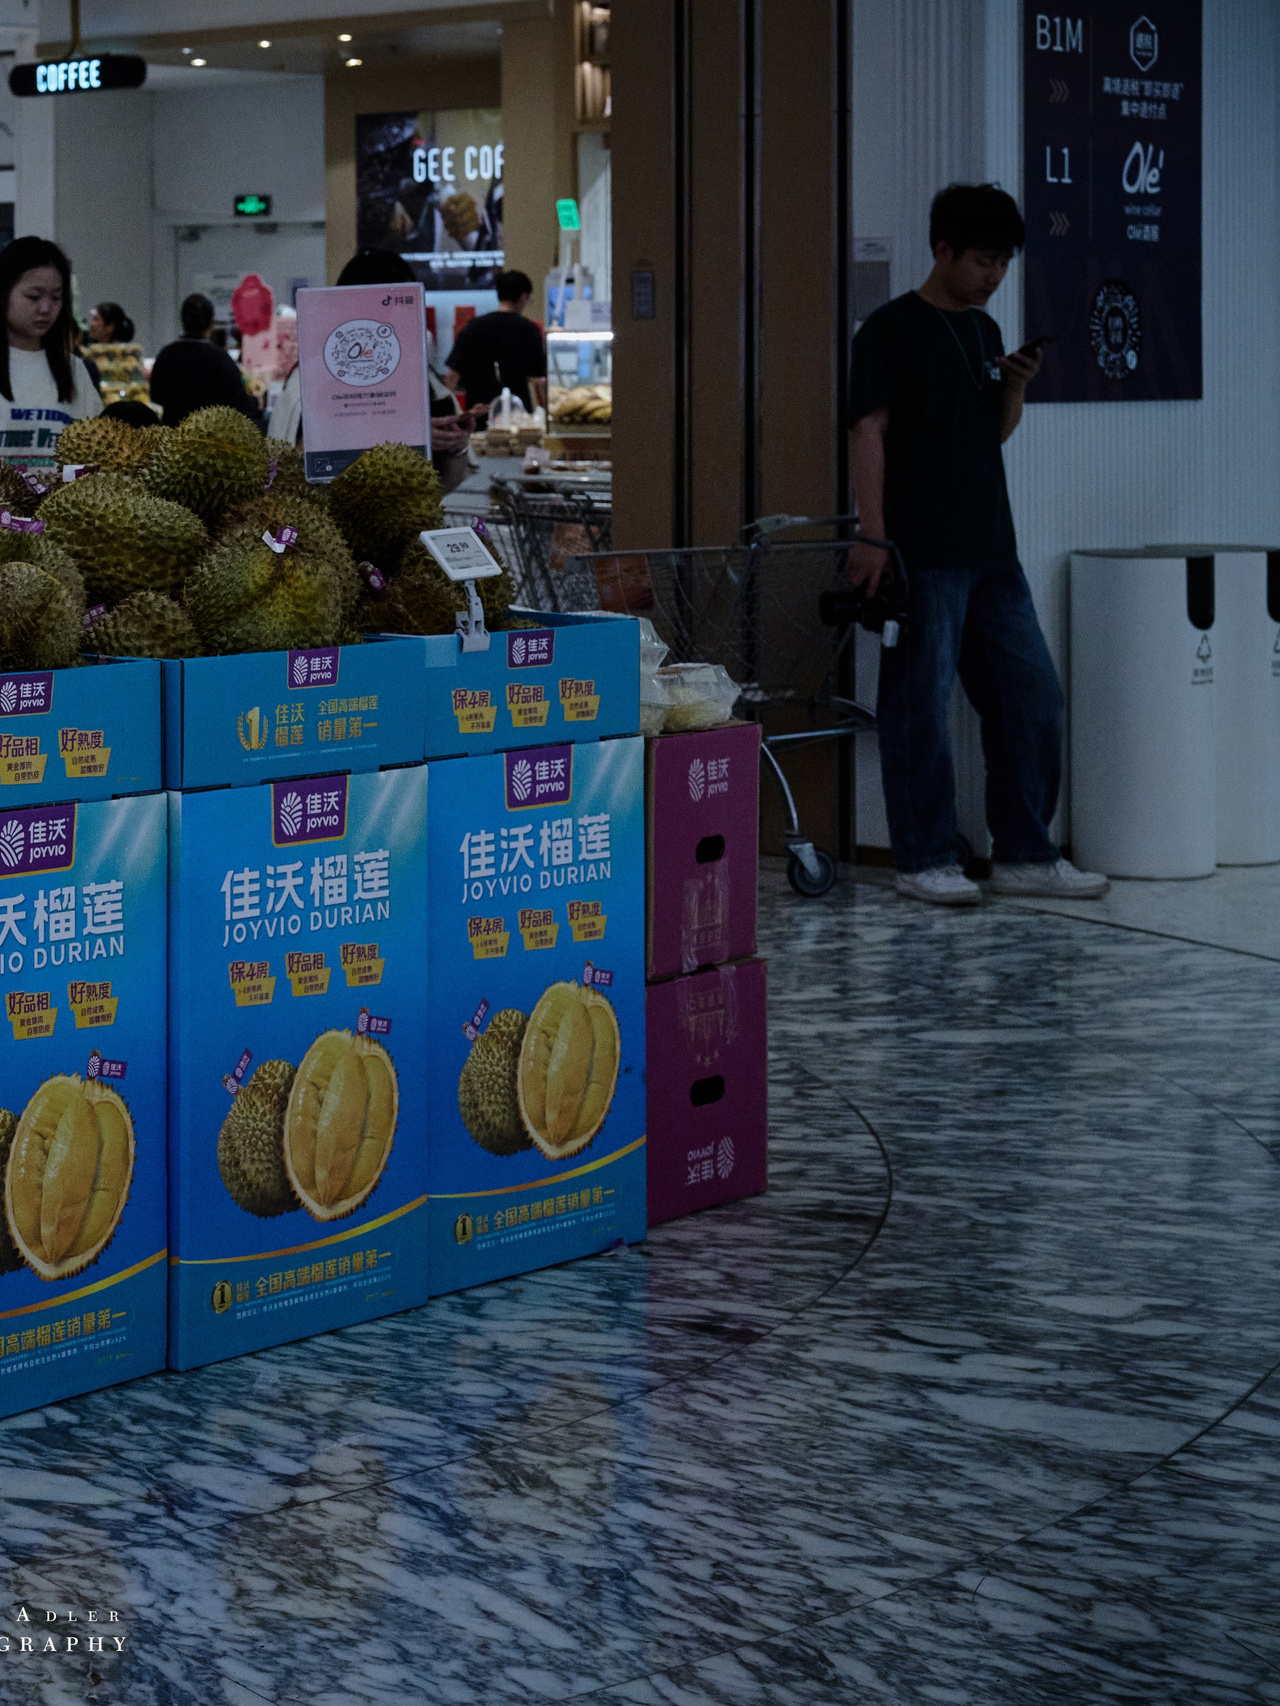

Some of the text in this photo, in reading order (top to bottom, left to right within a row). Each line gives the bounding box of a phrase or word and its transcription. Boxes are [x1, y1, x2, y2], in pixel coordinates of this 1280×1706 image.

[1036, 13, 1083, 54] B1M
[36, 59, 101, 93] COFFEE
[413, 147, 456, 183] GEE
[1046, 145, 1072, 184] L1
[528, 638, 549, 653] 佳沃
[310, 656, 332, 671] 佳沃
[528, 653, 548, 663] JOYVIO
[310, 671, 332, 683] JOYVIO
[20, 682, 46, 698] 佳沃
[453, 689, 489, 710] 保4房
[508, 684, 543, 705] 好品相
[20, 698, 44, 710] JOYVIO
[275, 703, 305, 725] 佳沃
[61, 728, 102, 752] 好熟度
[274, 724, 304, 747] 榴莲
[317, 717, 378, 742] 销量第一
[535, 758, 565, 781] 佳沃
[707, 758, 730, 780] 佳沃
[535, 783, 565, 798] JOYVIO
[306, 791, 339, 815] 佳沃
[29, 818, 67, 844] 佳沃
[306, 815, 339, 833] JOYVIO
[29, 845, 66, 864] JOYVIO
[459, 812, 611, 879] 佳沃榴莲
[220, 848, 390, 921] 佳沃榴莲
[461, 861, 611, 904] JOYVIO DURIAN
[222, 900, 390, 947] JOYVIO DURIAN
[468, 917, 503, 938] 保4房
[520, 909, 553, 929] 好品相
[34, 935, 124, 970] DURIAN
[287, 952, 323, 974] 好品相
[342, 944, 378, 965] 好熟度
[230, 961, 269, 984] 保4房
[8, 992, 50, 1016] 好品相
[70, 982, 110, 1005] 好熟度
